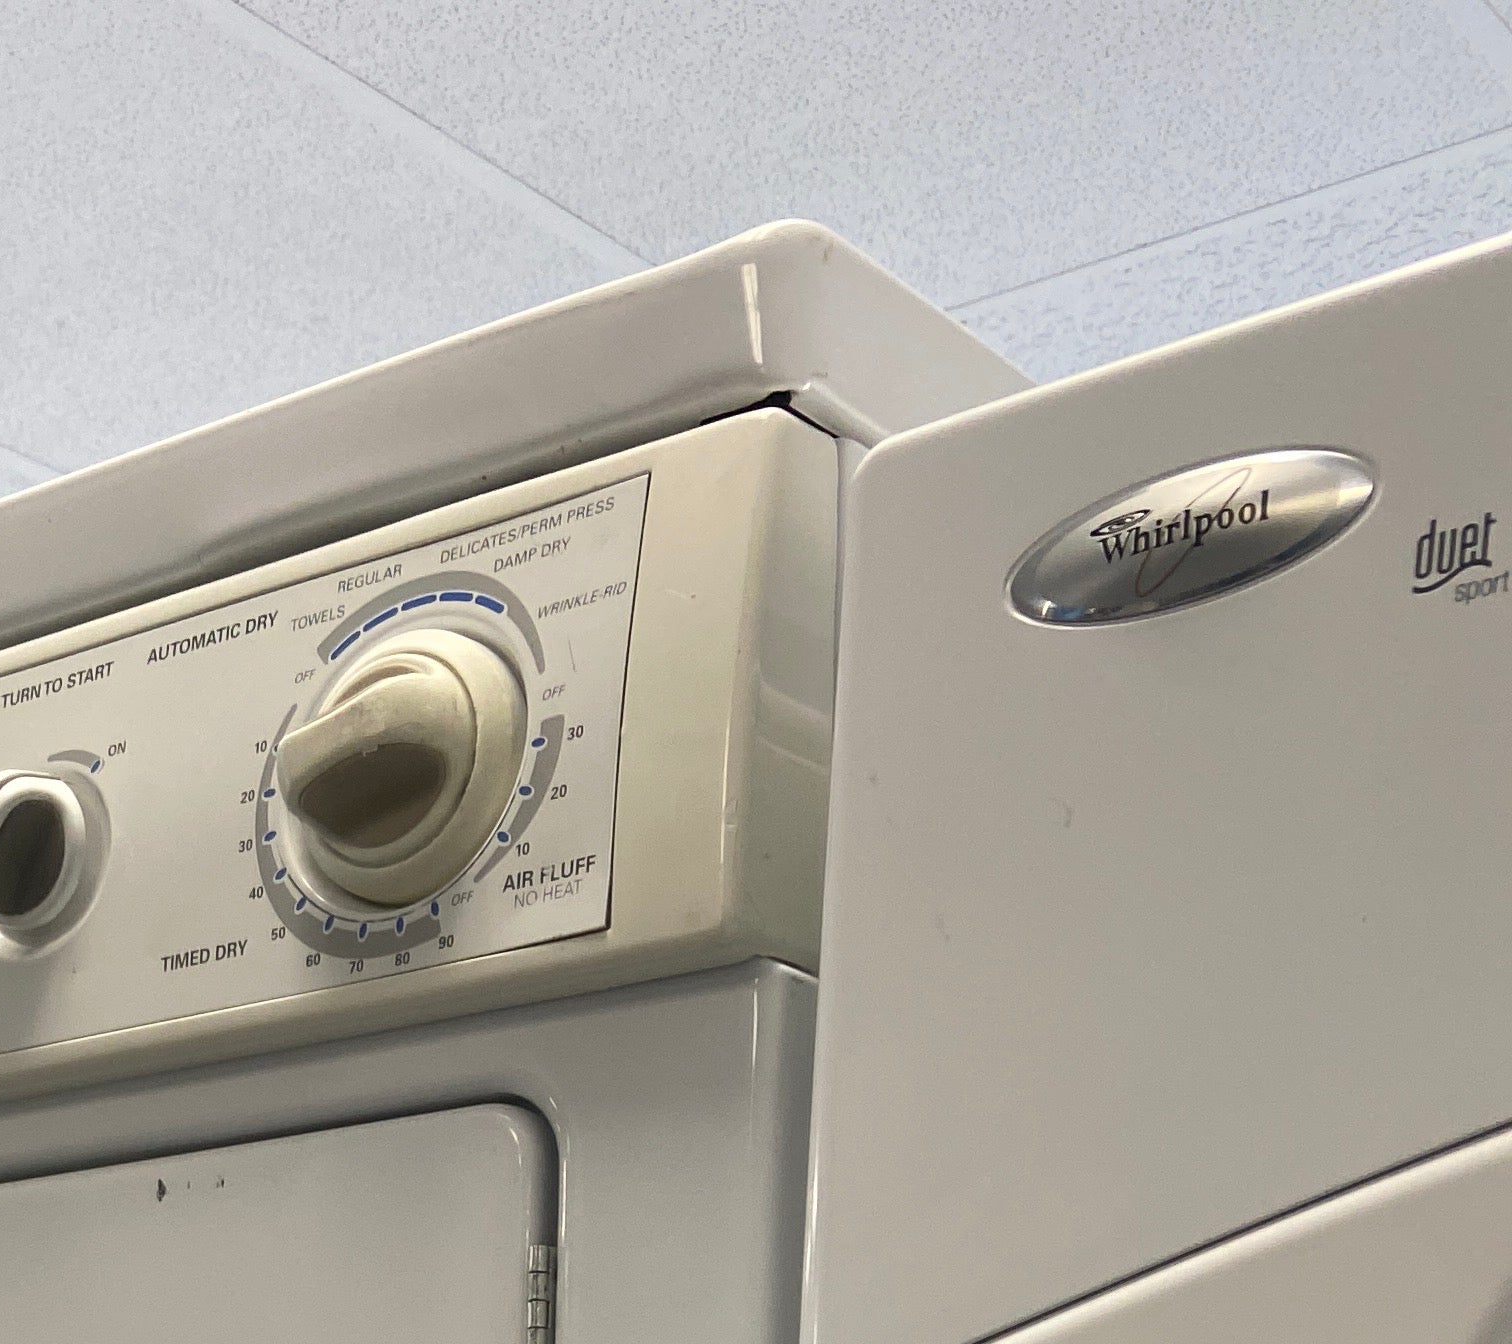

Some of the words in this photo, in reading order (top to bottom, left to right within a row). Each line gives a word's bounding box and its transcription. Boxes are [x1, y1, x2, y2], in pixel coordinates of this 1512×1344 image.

[440, 513, 563, 564] DELICATES/PERM
[567, 497, 616, 525] PRESS
[1098, 490, 1269, 564] Whirlpool
[493, 546, 536, 573] DAMP
[538, 536, 571, 563] DRY
[1414, 512, 1497, 580] duet
[337, 564, 403, 593] REGULAR
[1454, 570, 1509, 604] sport
[538, 581, 627, 619] WRINKLE-RID
[291, 605, 345, 632] TOWELS
[147, 624, 241, 665] AUTOMATIC
[245, 610, 279, 635] DRY
[1, 684, 41, 709] TURN
[44, 677, 62, 695] TO
[66, 661, 114, 688] START
[294, 669, 316, 684] OFF
[542, 684, 566, 701] OFF
[567, 725, 584, 740] 30
[107, 741, 127, 758] ON
[254, 740, 268, 755] 10
[240, 789, 255, 805] 20
[550, 784, 568, 800] 20
[238, 838, 254, 854] 30
[515, 842, 531, 857] 10
[502, 869, 535, 893] AIR
[540, 855, 597, 886] FLUFF
[249, 885, 264, 900] 40
[451, 890, 474, 907] OFF
[513, 890, 539, 910] NO
[542, 879, 583, 902] HEAT
[270, 926, 286, 942] 50
[438, 934, 455, 950] 90
[161, 948, 211, 974] TIMED
[215, 938, 249, 963] DRY
[305, 952, 321, 968] 60
[394, 952, 411, 968] 80
[348, 959, 364, 975] 70
